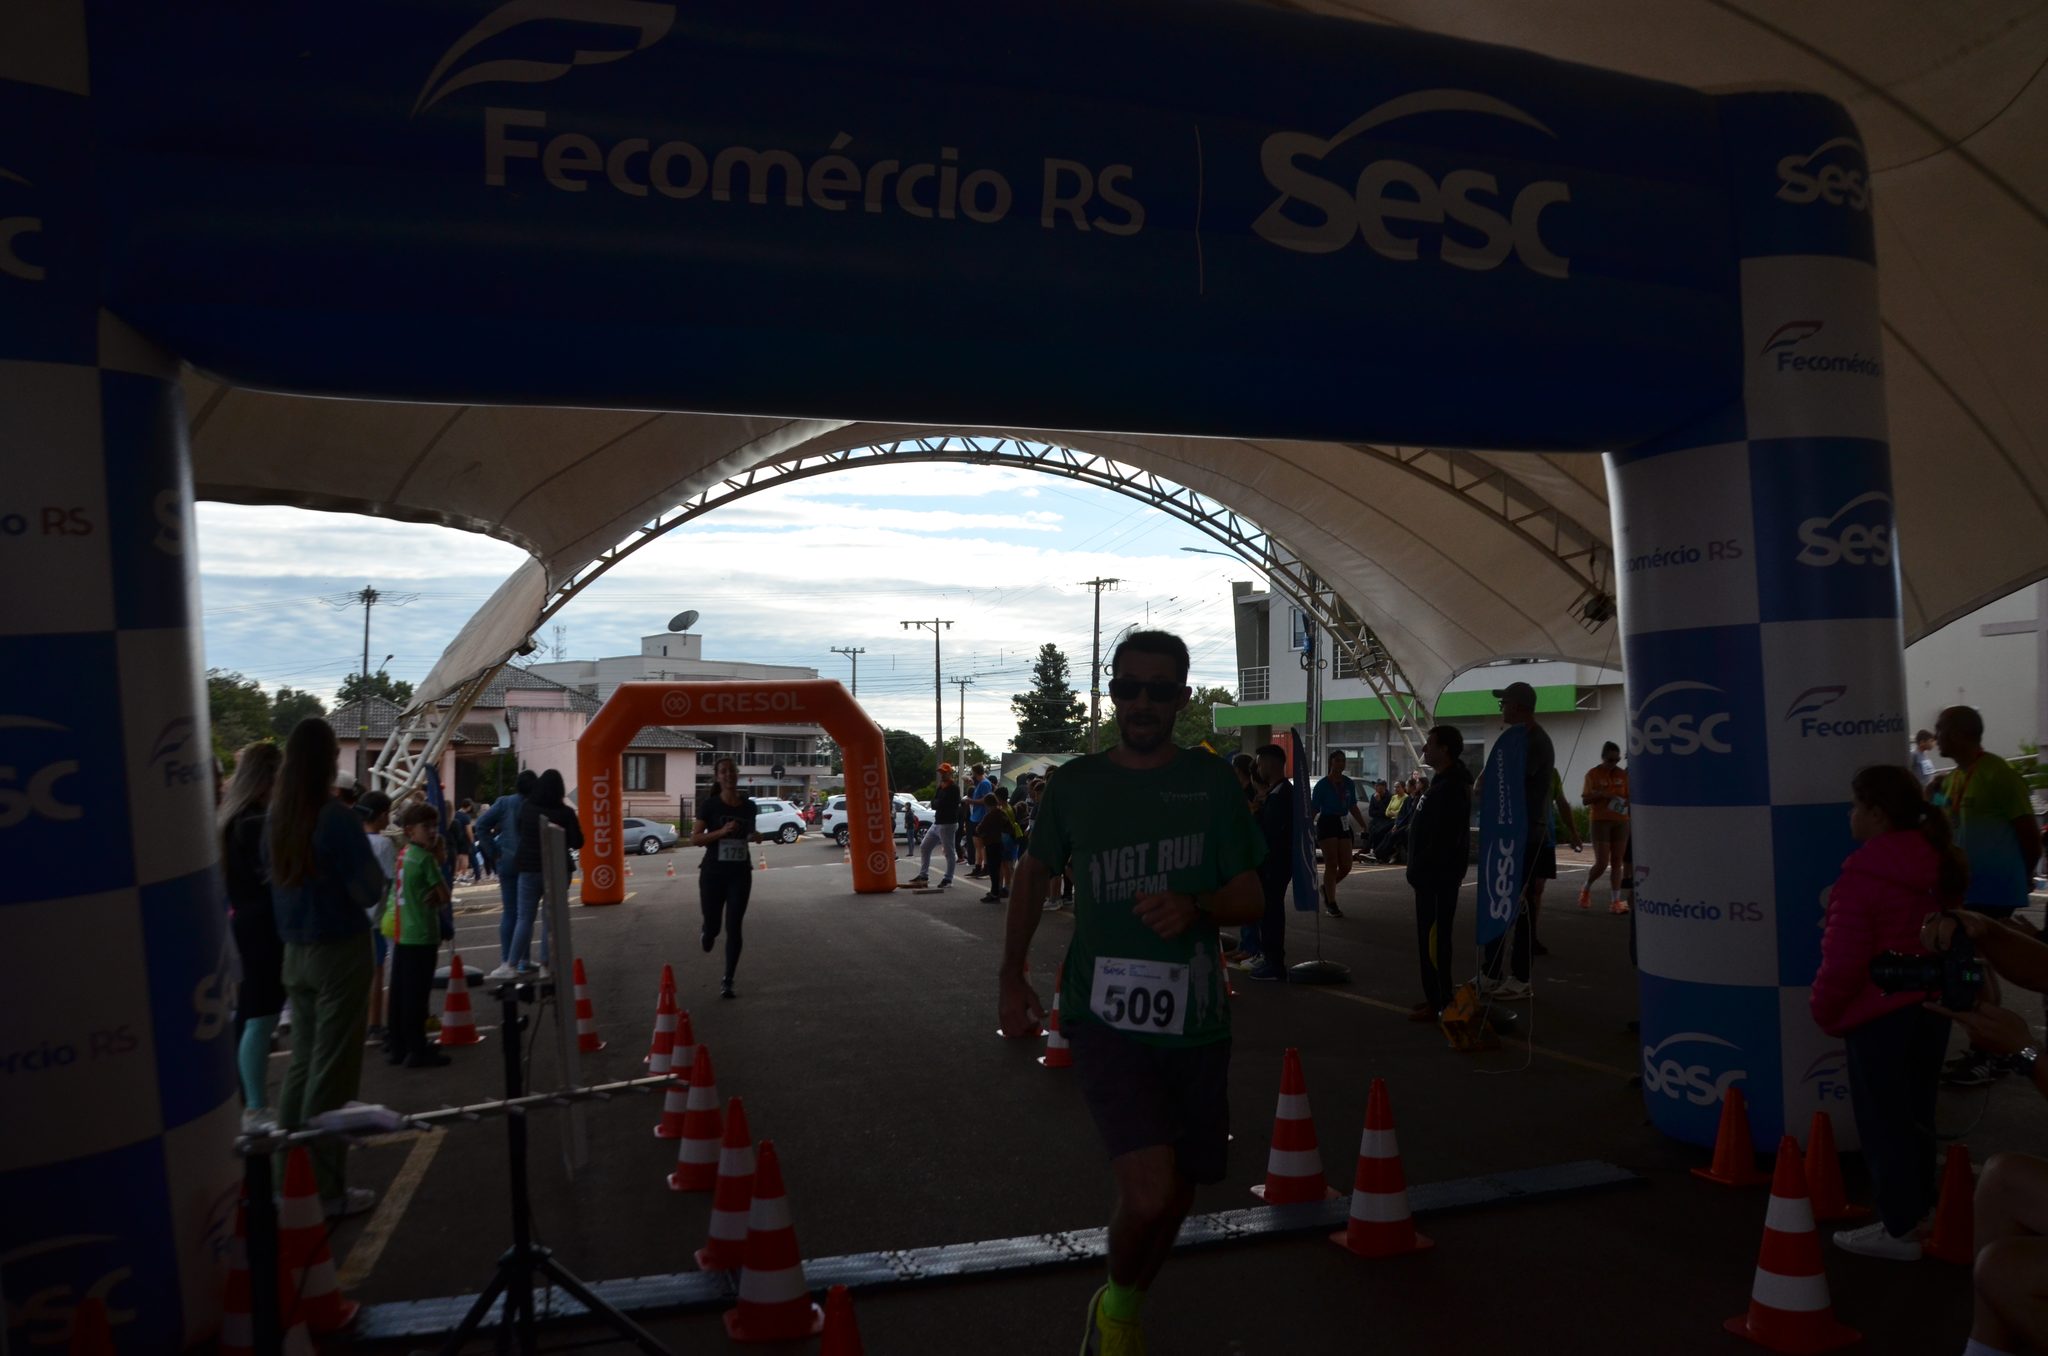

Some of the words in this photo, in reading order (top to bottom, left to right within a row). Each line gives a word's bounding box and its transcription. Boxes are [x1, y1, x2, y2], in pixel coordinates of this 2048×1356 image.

[484, 107, 1013, 224] Fecomércio
[1040, 157, 1147, 237] RS
[42, 507, 94, 536] RS
[1708, 539, 1744, 561] RS
[701, 690, 806, 714] CRESOL
[592, 767, 612, 859] CRESOL
[862, 756, 887, 845] CRESOL
[723, 847, 745, 860] 175
[1102, 842, 1150, 882] VGT
[1157, 832, 1206, 873] RUN
[1105, 872, 1168, 904] ITAPEMA
[1729, 901, 1764, 922] RS
[1102, 985, 1175, 1027] 509
[90, 1024, 138, 1060] RS
